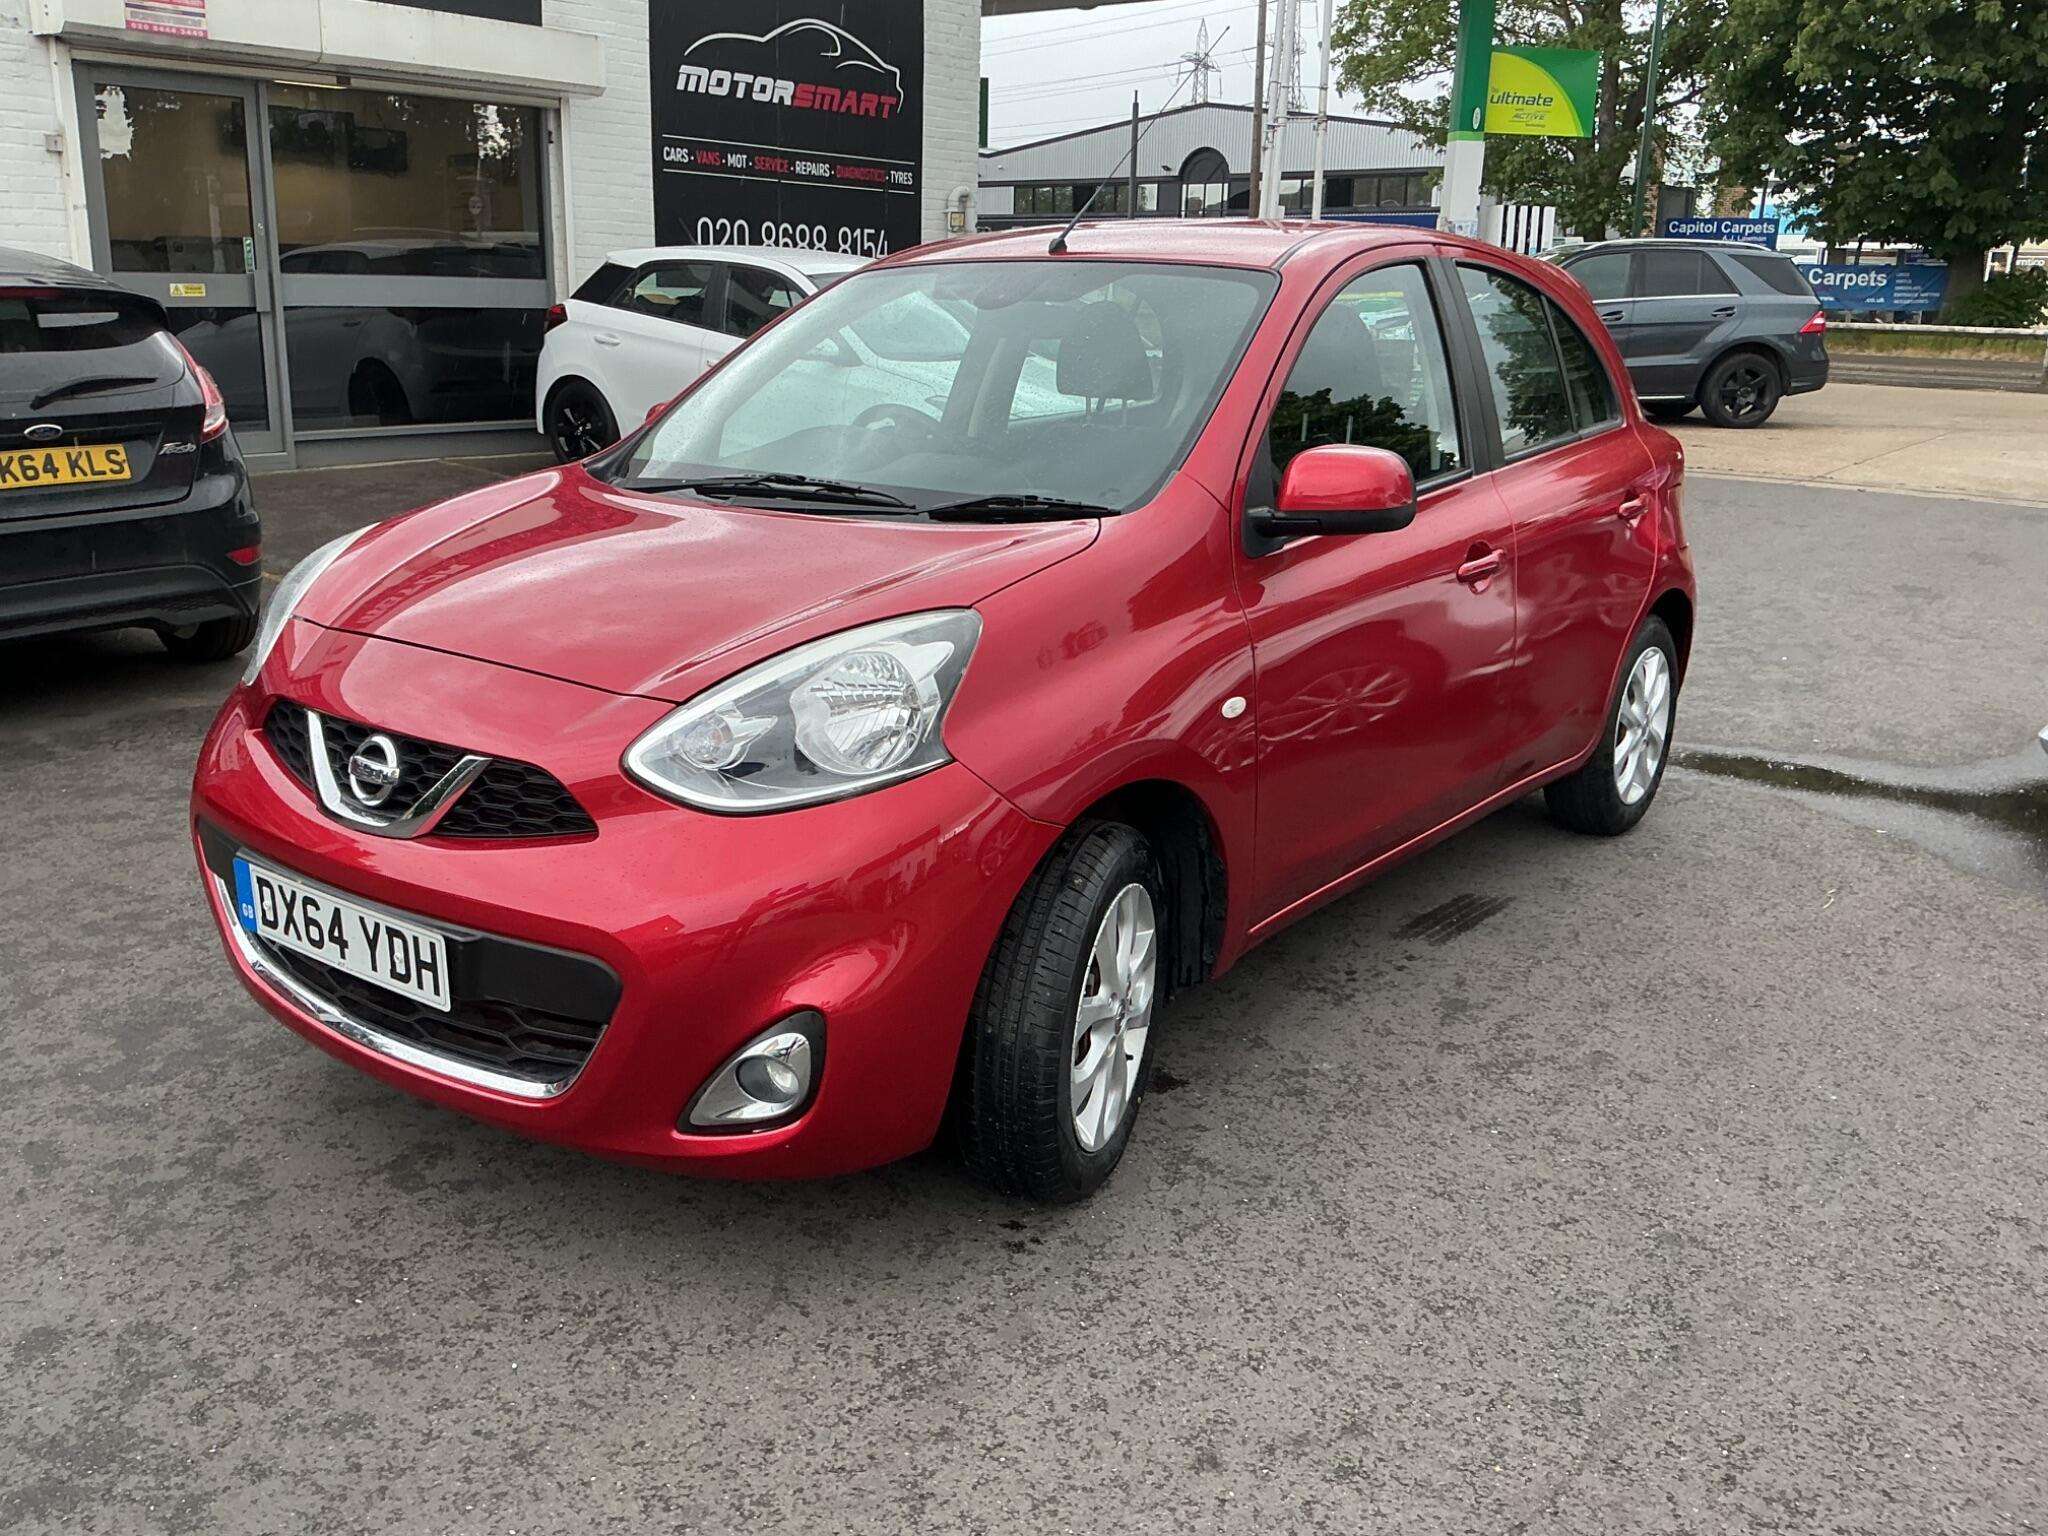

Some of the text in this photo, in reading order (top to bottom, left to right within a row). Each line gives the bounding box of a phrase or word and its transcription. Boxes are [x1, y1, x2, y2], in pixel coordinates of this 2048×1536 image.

[1490, 91, 1554, 107] ultimate
[1512, 112, 1545, 120] ACTIVE
[663, 146, 689, 164] CARS
[695, 151, 720, 166] VANS
[727, 153, 748, 169] MOT
[754, 156, 790, 174] SERVICE
[795, 160, 830, 177] REPAIRS
[890, 170, 913, 185] TYRES
[697, 216, 750, 246] 020
[838, 226, 888, 259] 8154
[1668, 220, 1775, 236] Capitol Carpets
[1808, 267, 1887, 290] Carpets
[66, 449, 126, 478] KLS
[241, 902, 255, 919] GB
[256, 875, 441, 997] DX64 YDH
